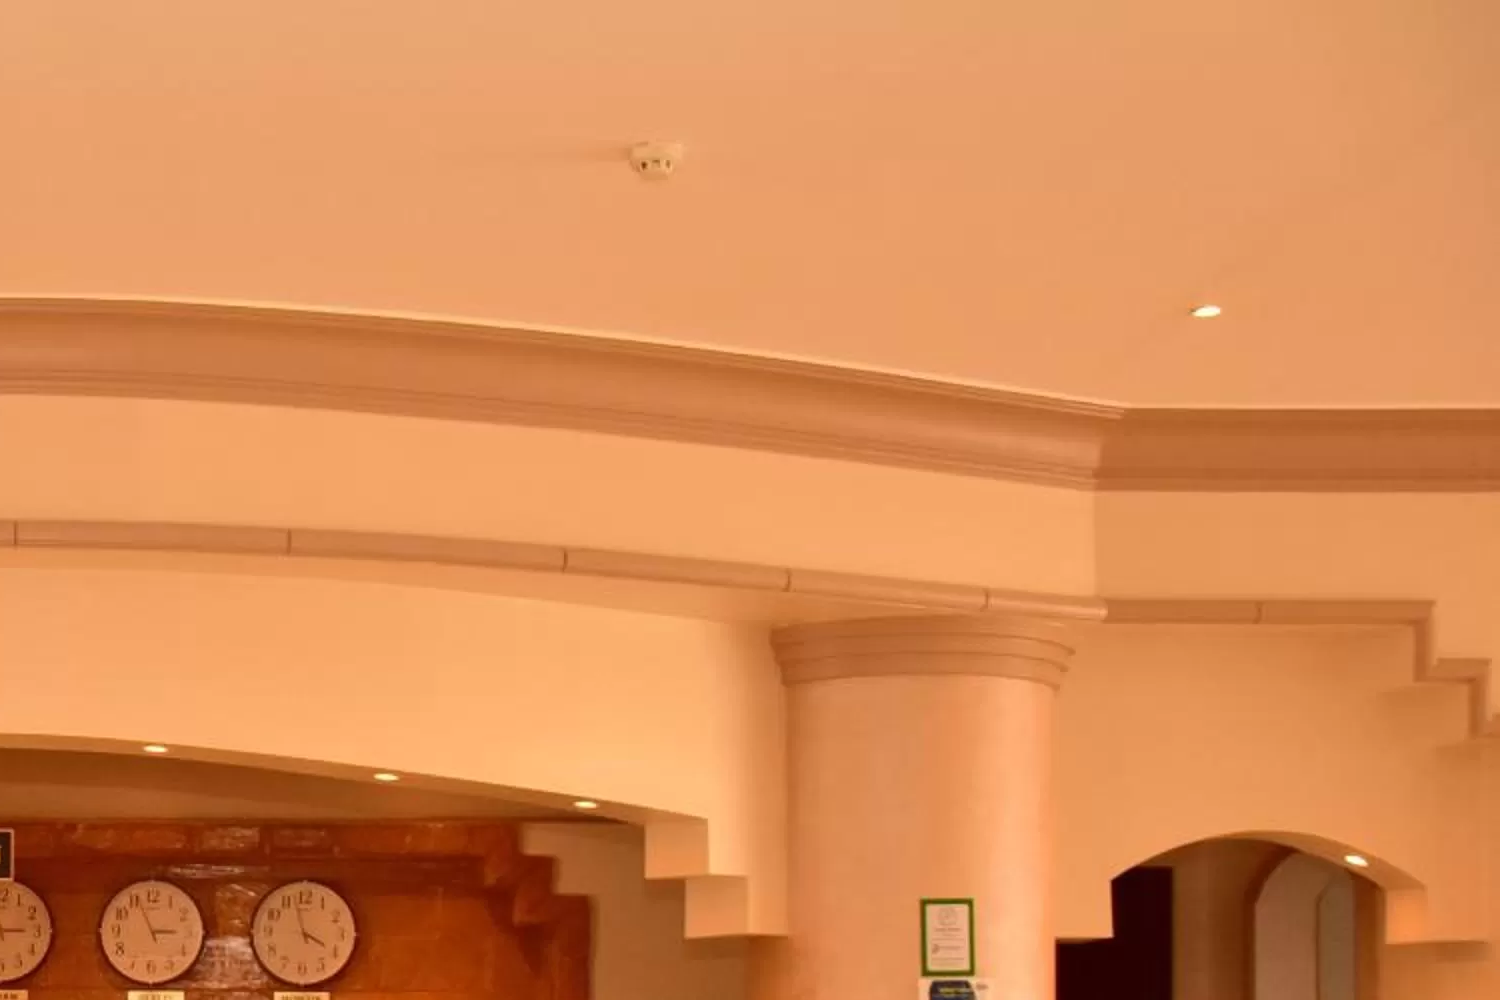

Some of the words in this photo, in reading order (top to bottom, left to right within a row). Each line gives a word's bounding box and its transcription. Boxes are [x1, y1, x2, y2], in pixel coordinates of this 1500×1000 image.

[129, 894, 139, 909] 11
[147, 888, 160, 903] 12
[281, 895, 291, 909] 11
[298, 889, 313, 904] 12
[28, 905, 37, 920] 2
[116, 906, 129, 921] 10
[179, 907, 189, 922] 2
[267, 907, 281, 921] 10
[330, 907, 340, 923] 2
[33, 923, 41, 938] 3
[111, 923, 121, 938] 9
[263, 924, 273, 938] 9
[337, 927, 345, 942] 3
[28, 943, 36, 956] 4
[115, 942, 124, 957] 8
[178, 943, 186, 957] 4
[267, 943, 276, 959] 8
[330, 943, 337, 959] 4
[14, 952, 23, 968] 5
[146, 959, 157, 974] 6
[316, 957, 325, 972] 5
[297, 962, 307, 976] 6
